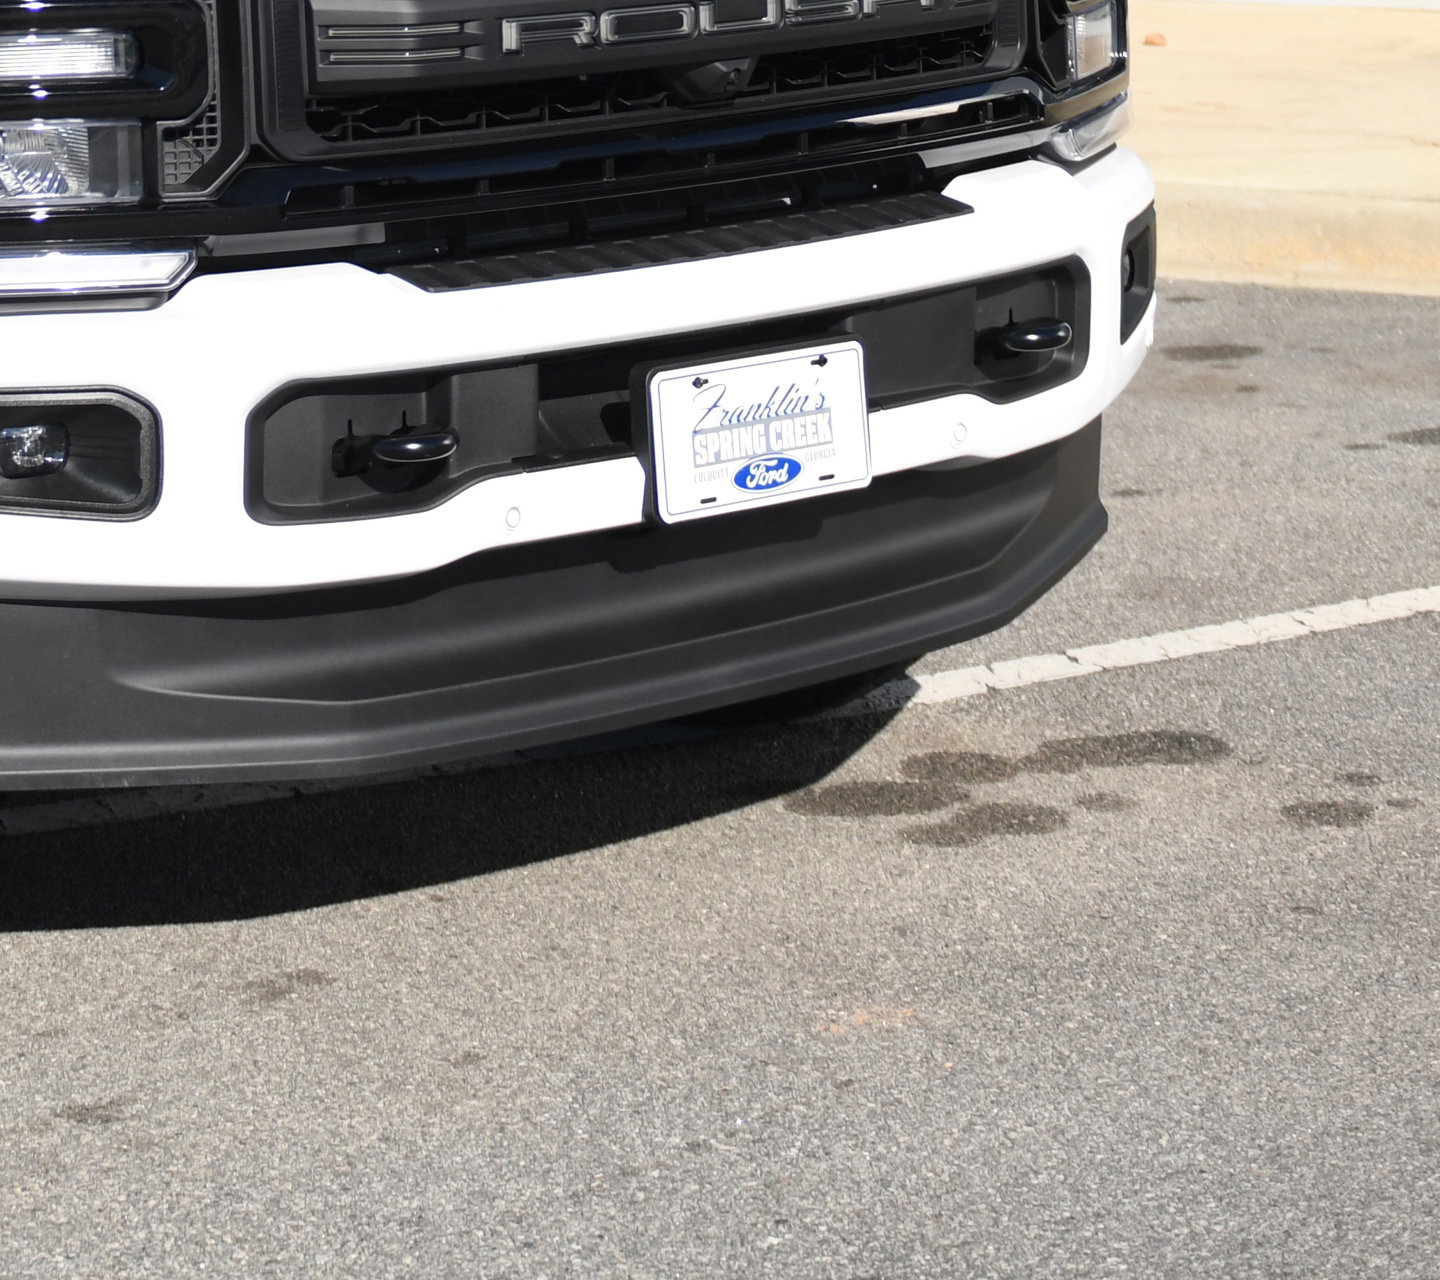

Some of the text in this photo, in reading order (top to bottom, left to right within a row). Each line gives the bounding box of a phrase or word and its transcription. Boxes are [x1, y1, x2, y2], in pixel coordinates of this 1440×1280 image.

[692, 377, 826, 435] Franklin's
[693, 411, 833, 466] SPRING CREEK
[804, 448, 836, 463] GEORGIA
[745, 459, 789, 489] Ford
